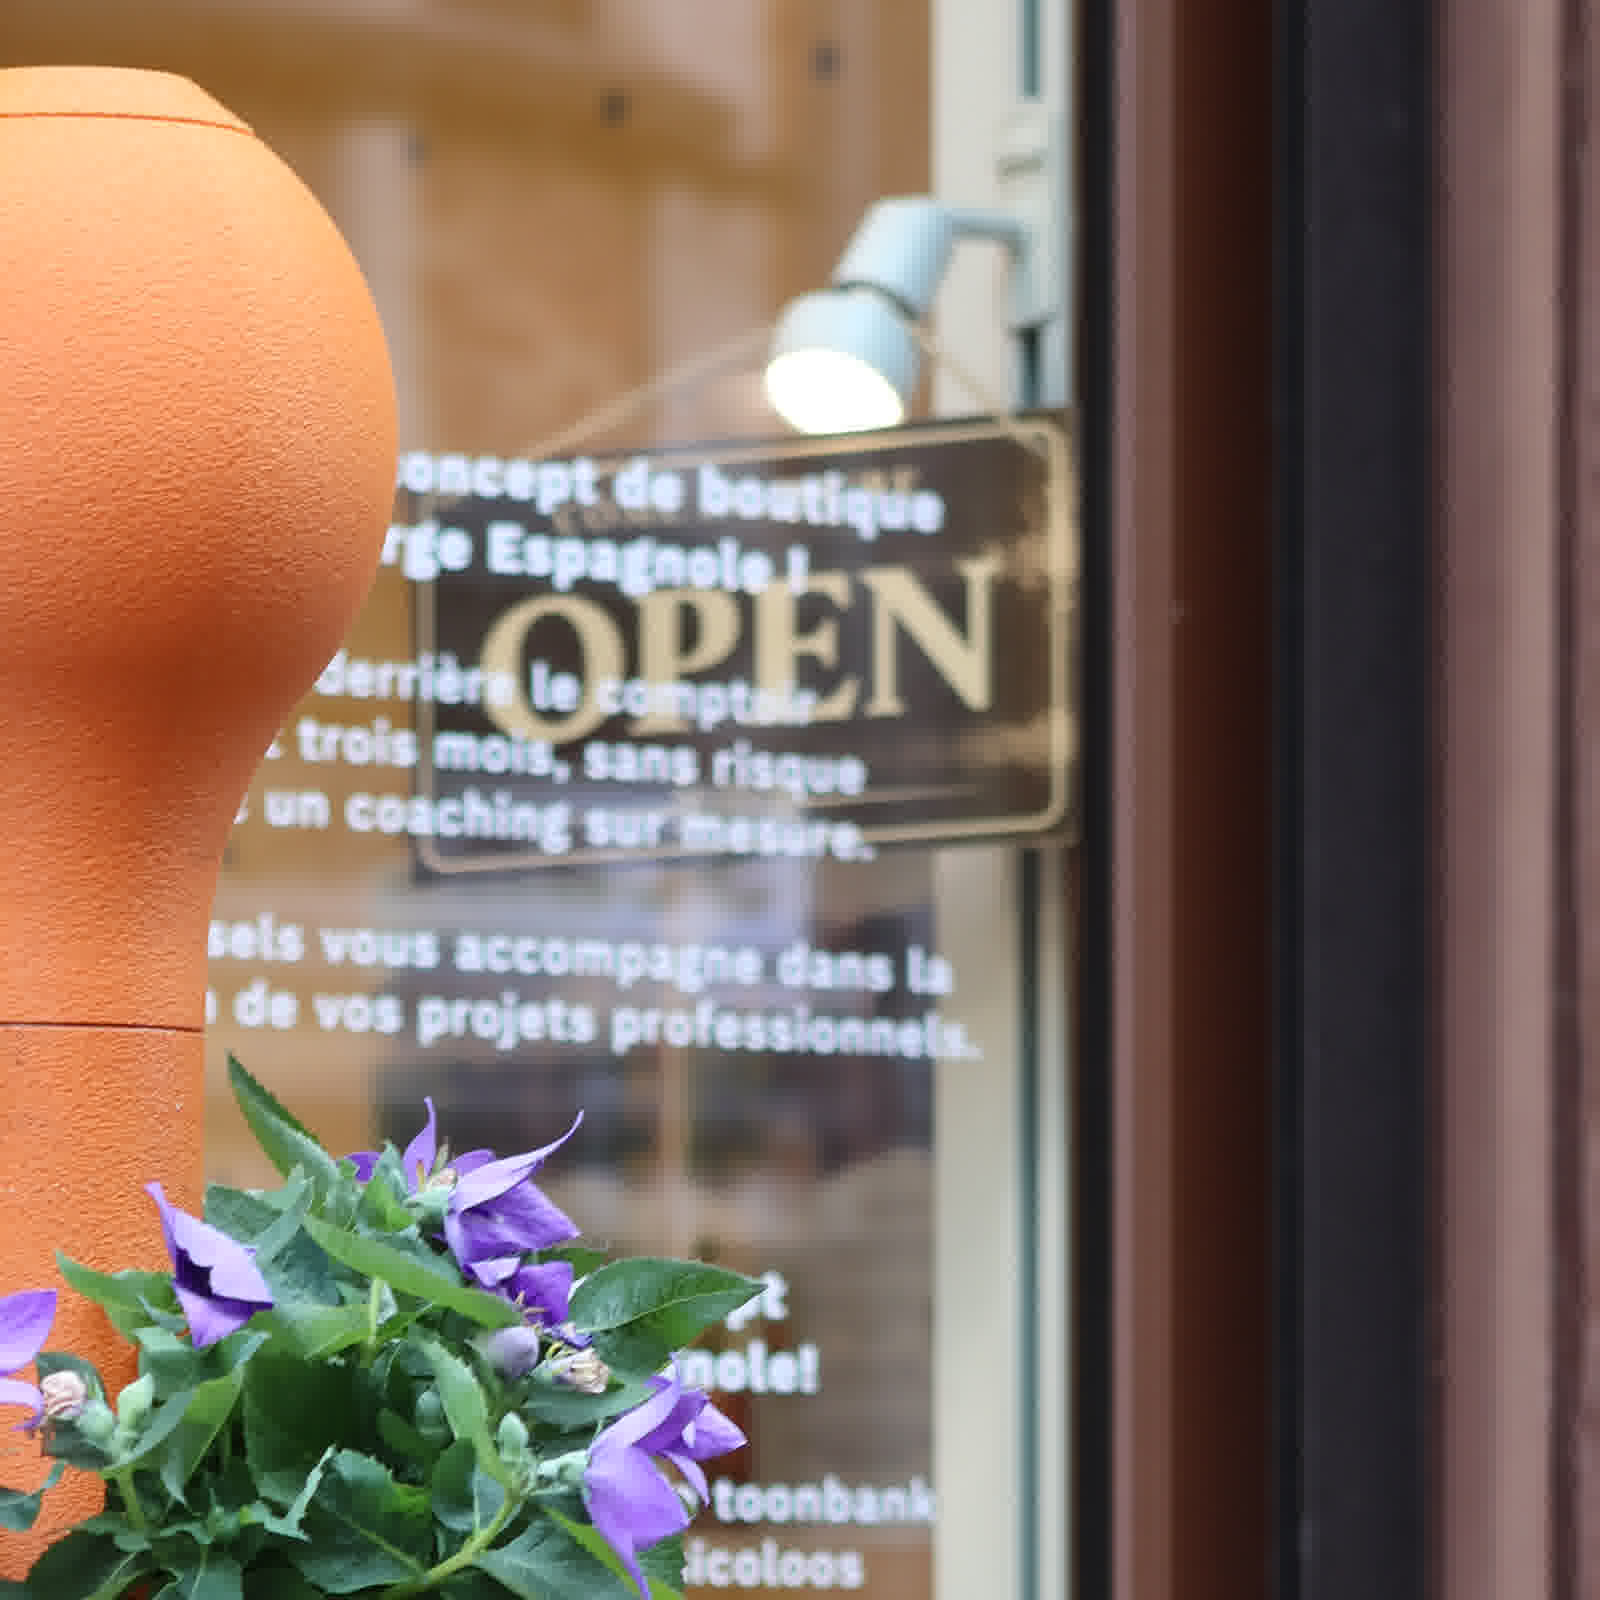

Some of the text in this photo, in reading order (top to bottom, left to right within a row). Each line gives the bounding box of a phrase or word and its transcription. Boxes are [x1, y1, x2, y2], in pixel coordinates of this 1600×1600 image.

[613, 456, 686, 512] de
[698, 463, 946, 541] boutique
[486, 520, 775, 598] Espagnole
[479, 546, 1002, 745] OPEN
[531, 662, 583, 712] le
[298, 718, 868, 797] trois mois, sans risque
[263, 790, 331, 830] un
[344, 787, 573, 855] coaching
[584, 807, 666, 852] sur
[318, 928, 440, 971] vous
[454, 930, 764, 993] accompagne
[776, 940, 894, 993] dans
[906, 945, 956, 996] la
[234, 977, 301, 1029] de
[311, 993, 404, 1036] vos
[416, 988, 596, 1050] projets
[712, 1472, 942, 1527] toonbank
